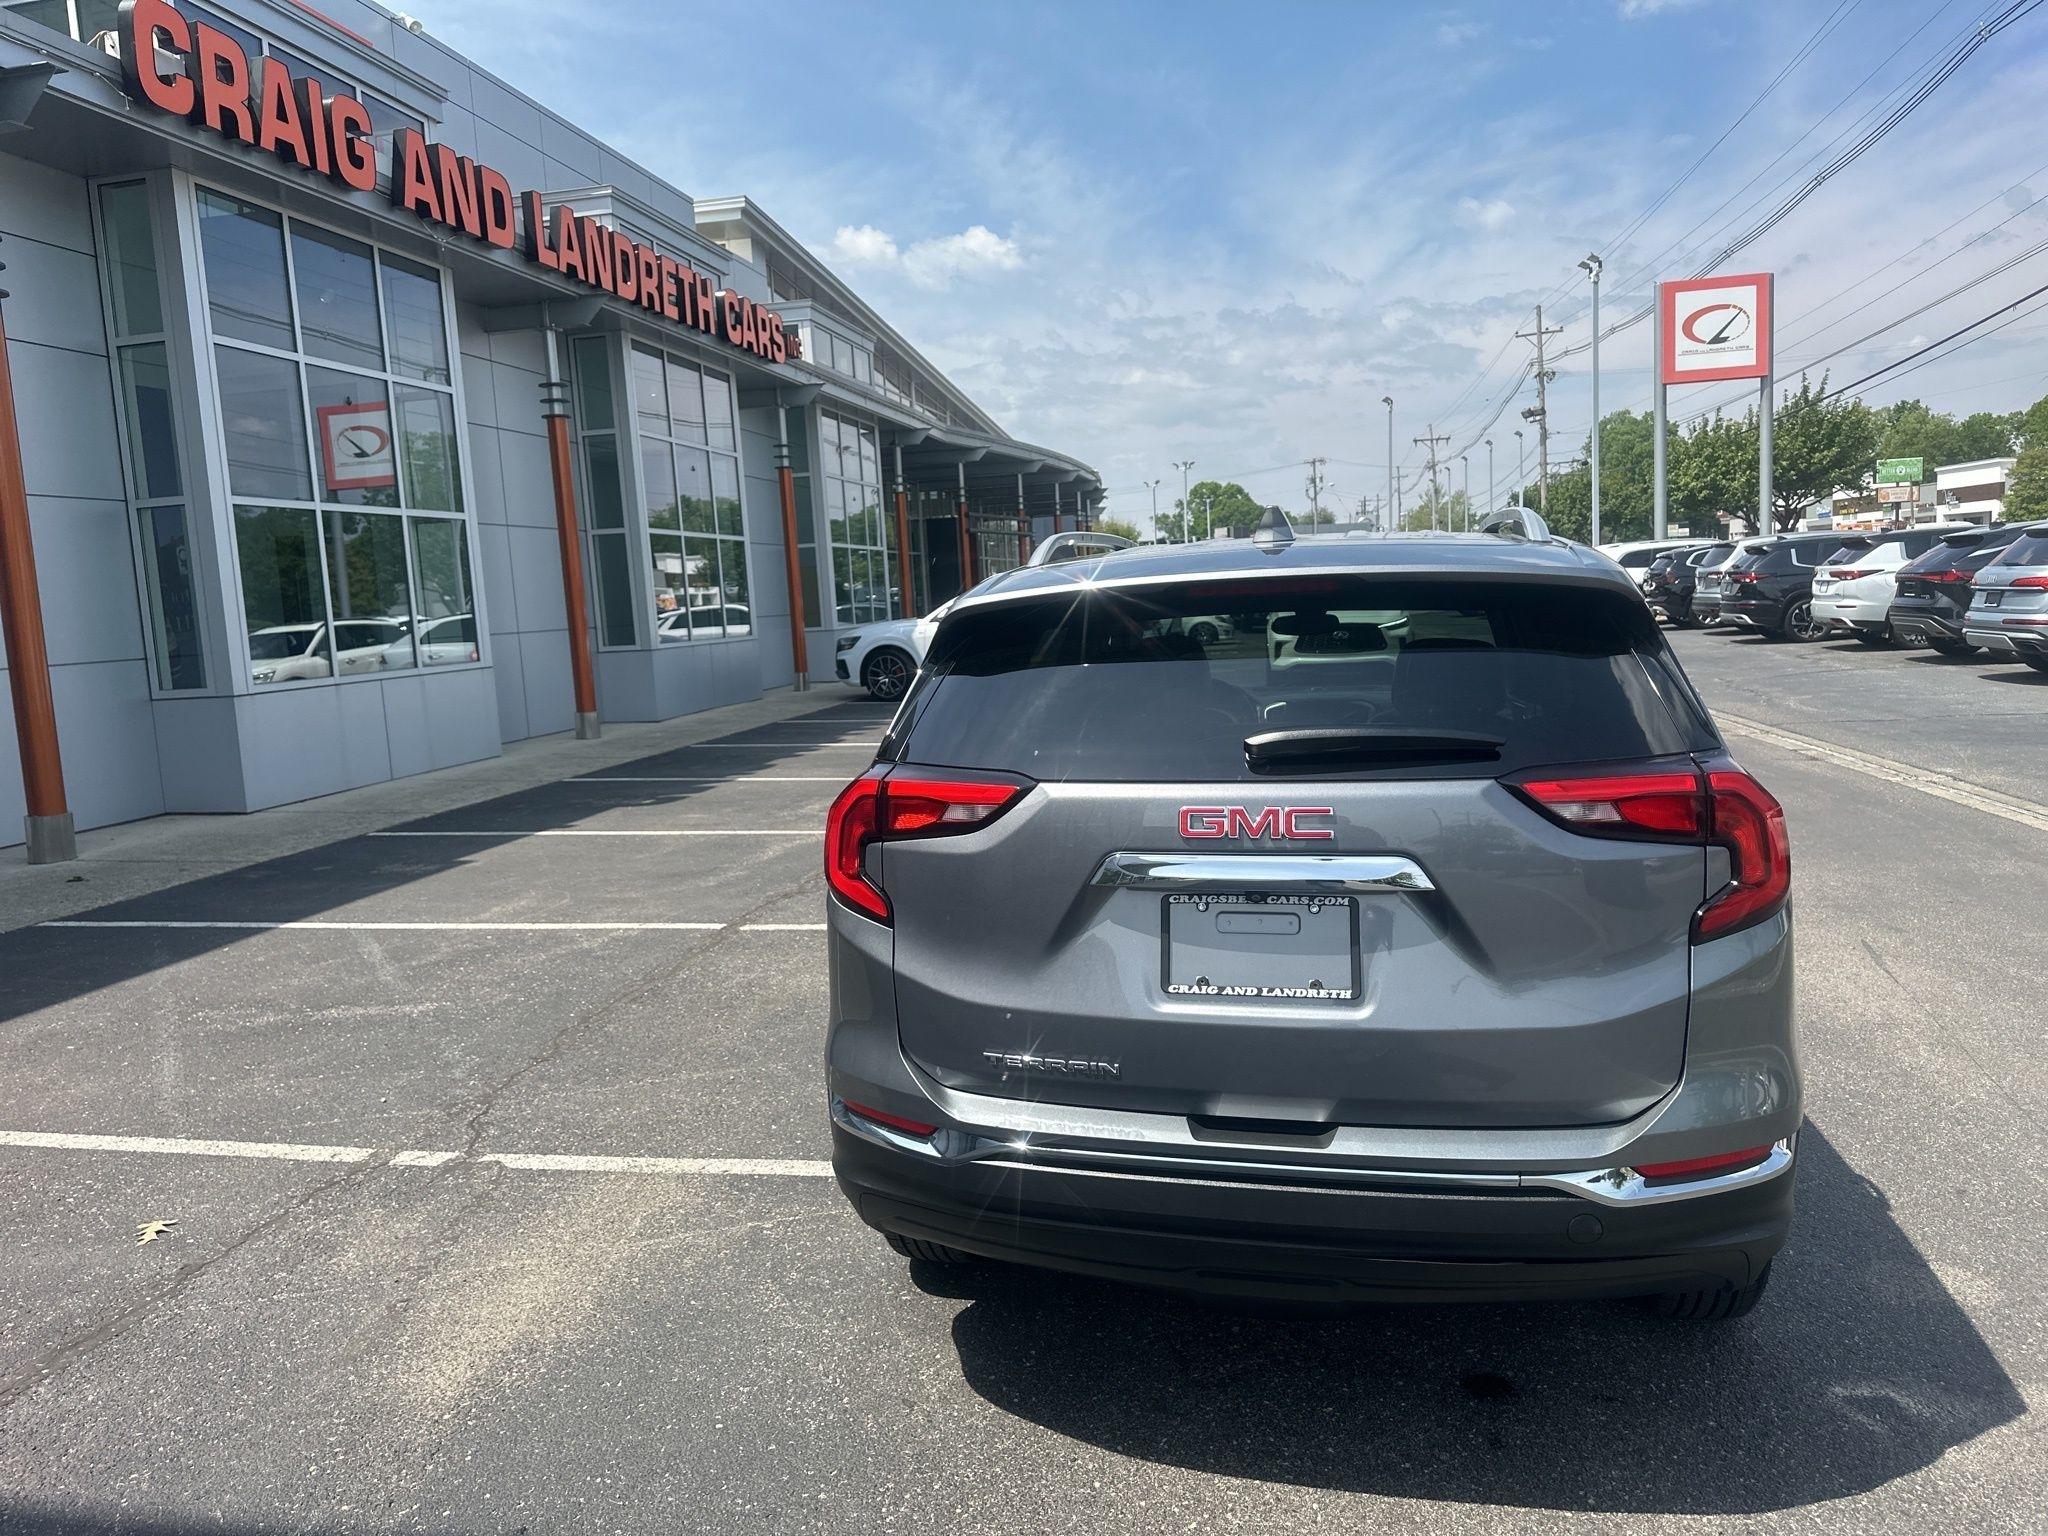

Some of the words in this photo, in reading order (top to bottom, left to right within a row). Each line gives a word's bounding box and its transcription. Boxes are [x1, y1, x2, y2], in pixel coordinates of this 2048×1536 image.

[131, 0, 377, 192] CRAIG
[403, 127, 516, 249] AND
[531, 190, 717, 336] LANDRETH
[723, 288, 786, 364] CARS
[1179, 805, 1334, 839] GMC
[1168, 894, 1350, 906] CRAIGSBECARS.COM
[1168, 984, 1219, 995] CRAIG
[1222, 985, 1258, 997] AND
[1260, 987, 1352, 999] LANDRETH
[982, 1052, 1120, 1077] TERRAIN
